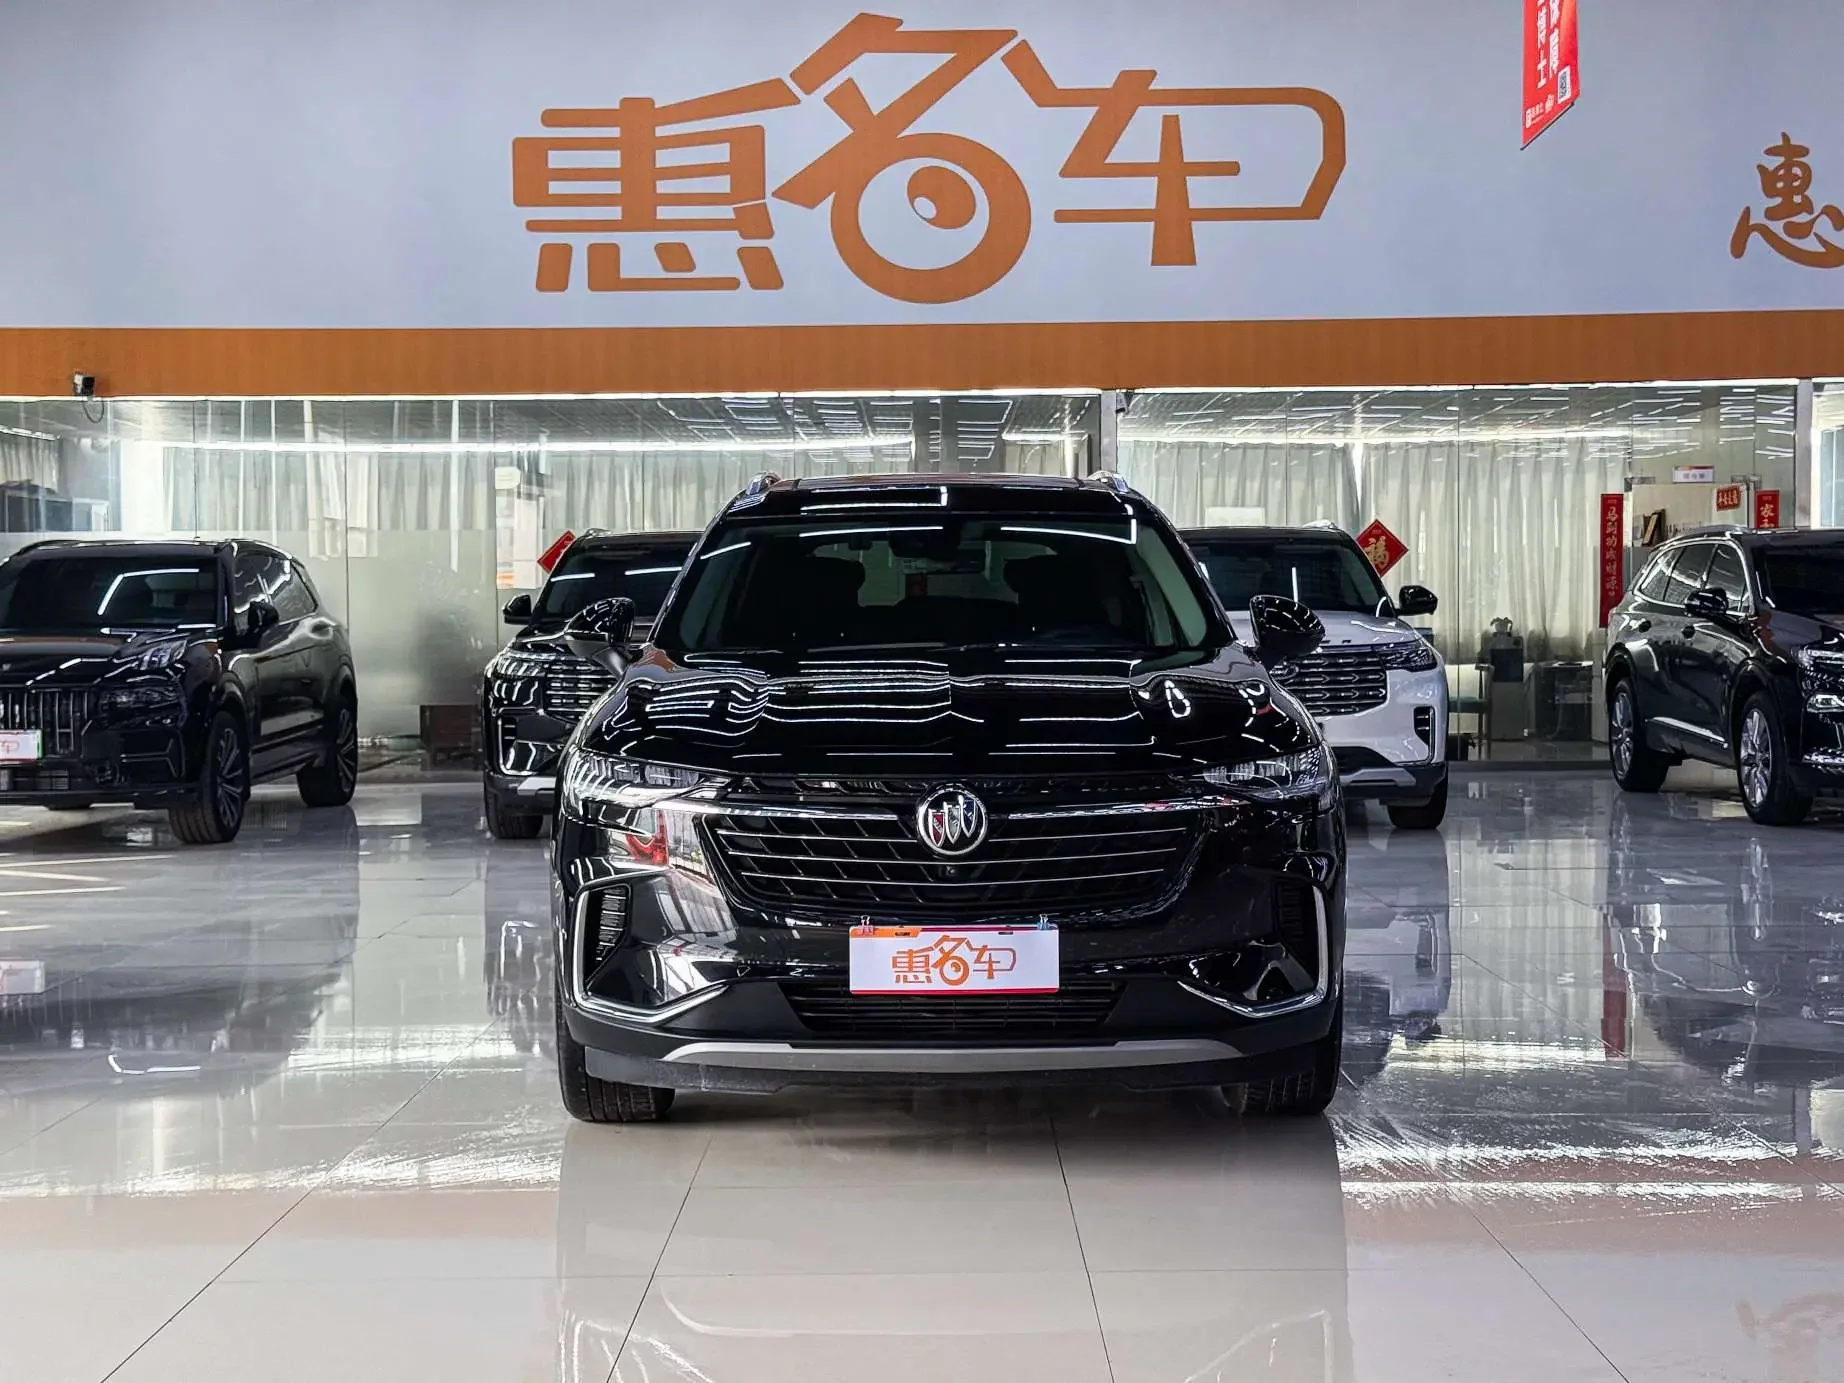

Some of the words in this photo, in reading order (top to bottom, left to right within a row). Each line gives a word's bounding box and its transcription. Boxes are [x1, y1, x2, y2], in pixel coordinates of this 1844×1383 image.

[512, 12, 1346, 304] 惠名车
[891, 935, 1017, 986] 惠名车
